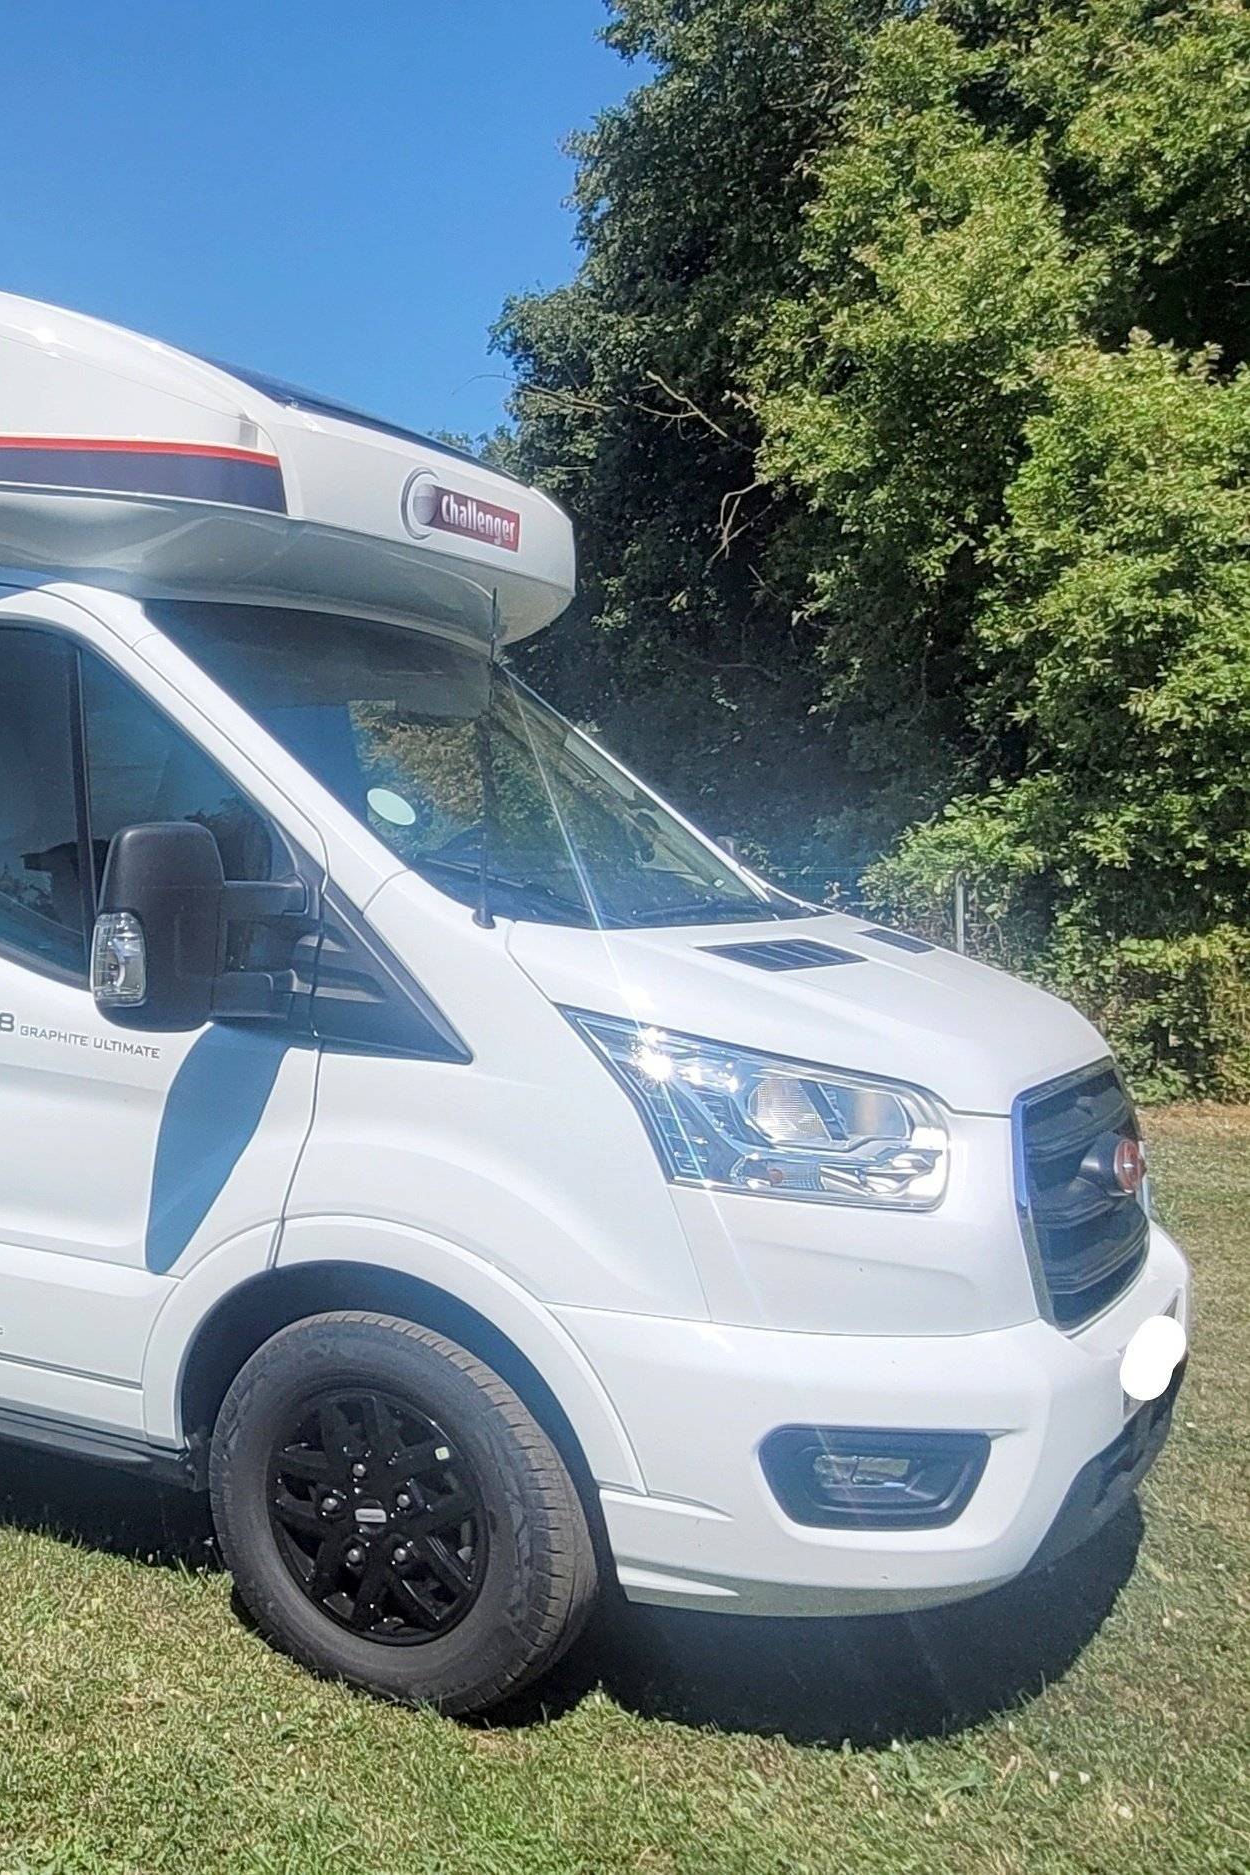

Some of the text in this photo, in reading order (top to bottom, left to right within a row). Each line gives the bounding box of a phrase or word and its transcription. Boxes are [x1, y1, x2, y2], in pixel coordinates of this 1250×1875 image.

[441, 494, 516, 545] Challenger
[20, 1025, 89, 1047] GRAPHITE
[93, 1037, 161, 1059] ULTIMATE
